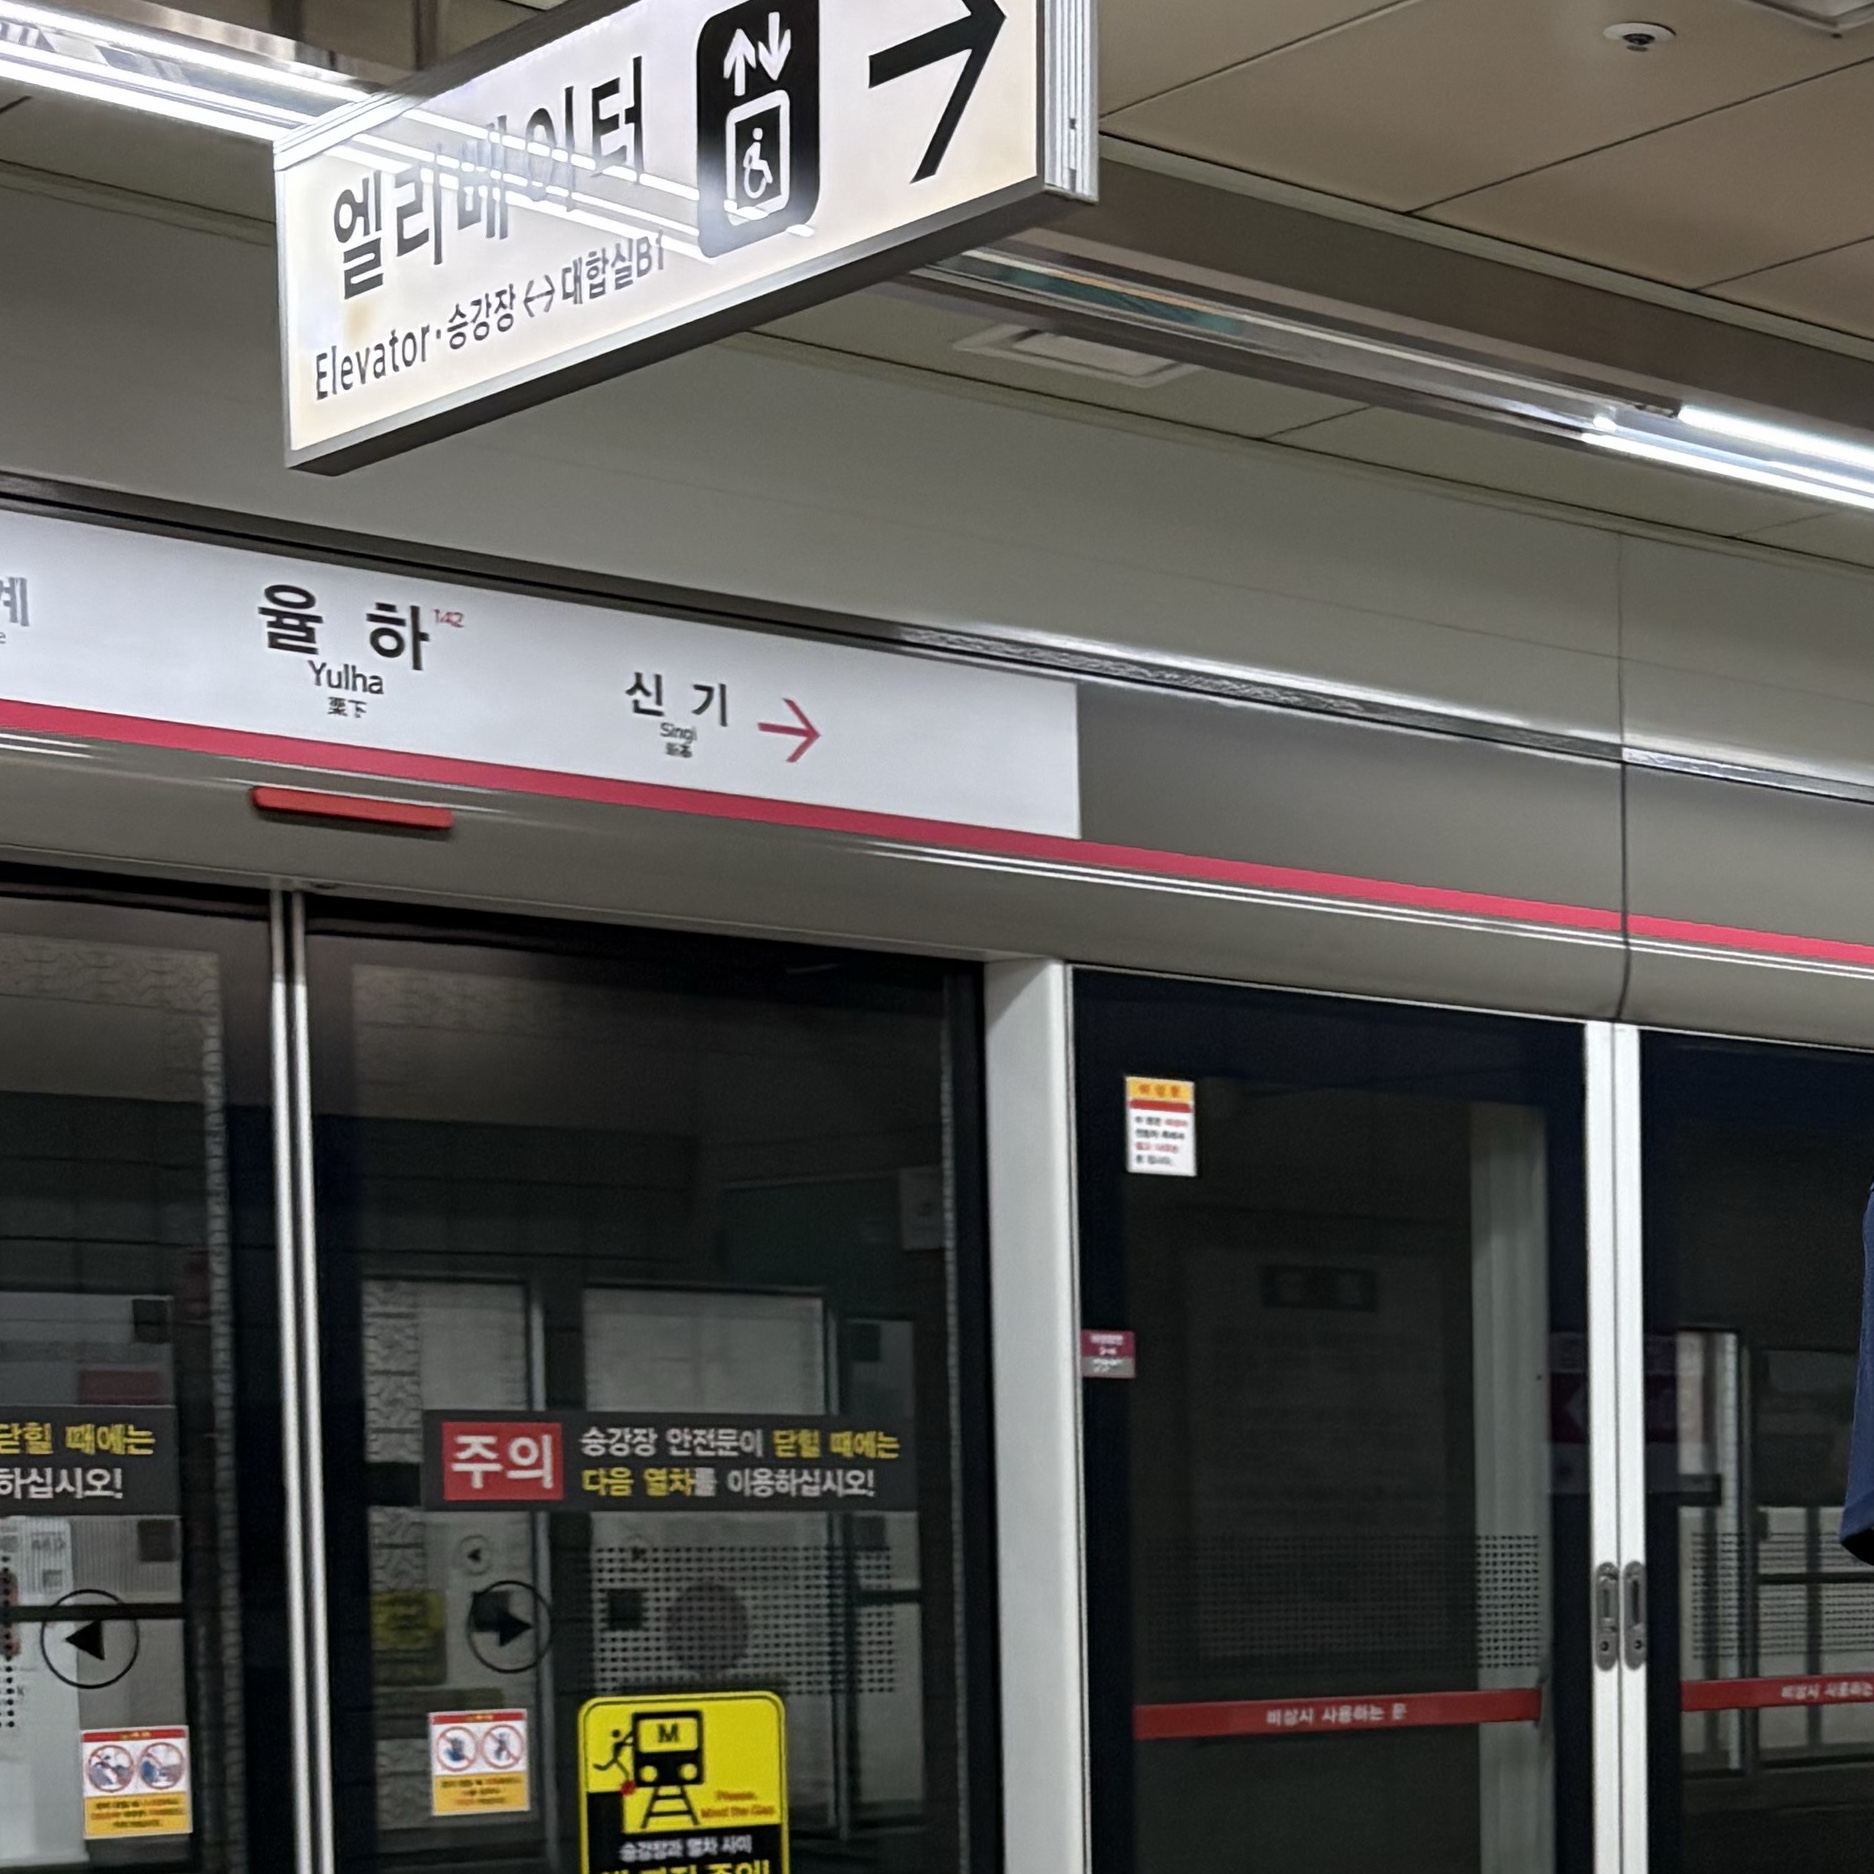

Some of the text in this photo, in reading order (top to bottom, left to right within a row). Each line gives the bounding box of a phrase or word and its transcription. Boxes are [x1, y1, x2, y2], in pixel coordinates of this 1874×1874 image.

[333, 55, 646, 299] 엘리베이터
[307, 659, 384, 695] Yulha
[65, 1423, 156, 1455] 때에는
[578, 1426, 901, 1460] 승강장 안전문이 닫힐 때에는
[451, 1433, 554, 1489] 주의
[580, 1466, 876, 1498] 다음 열차를 이용하십시오!
